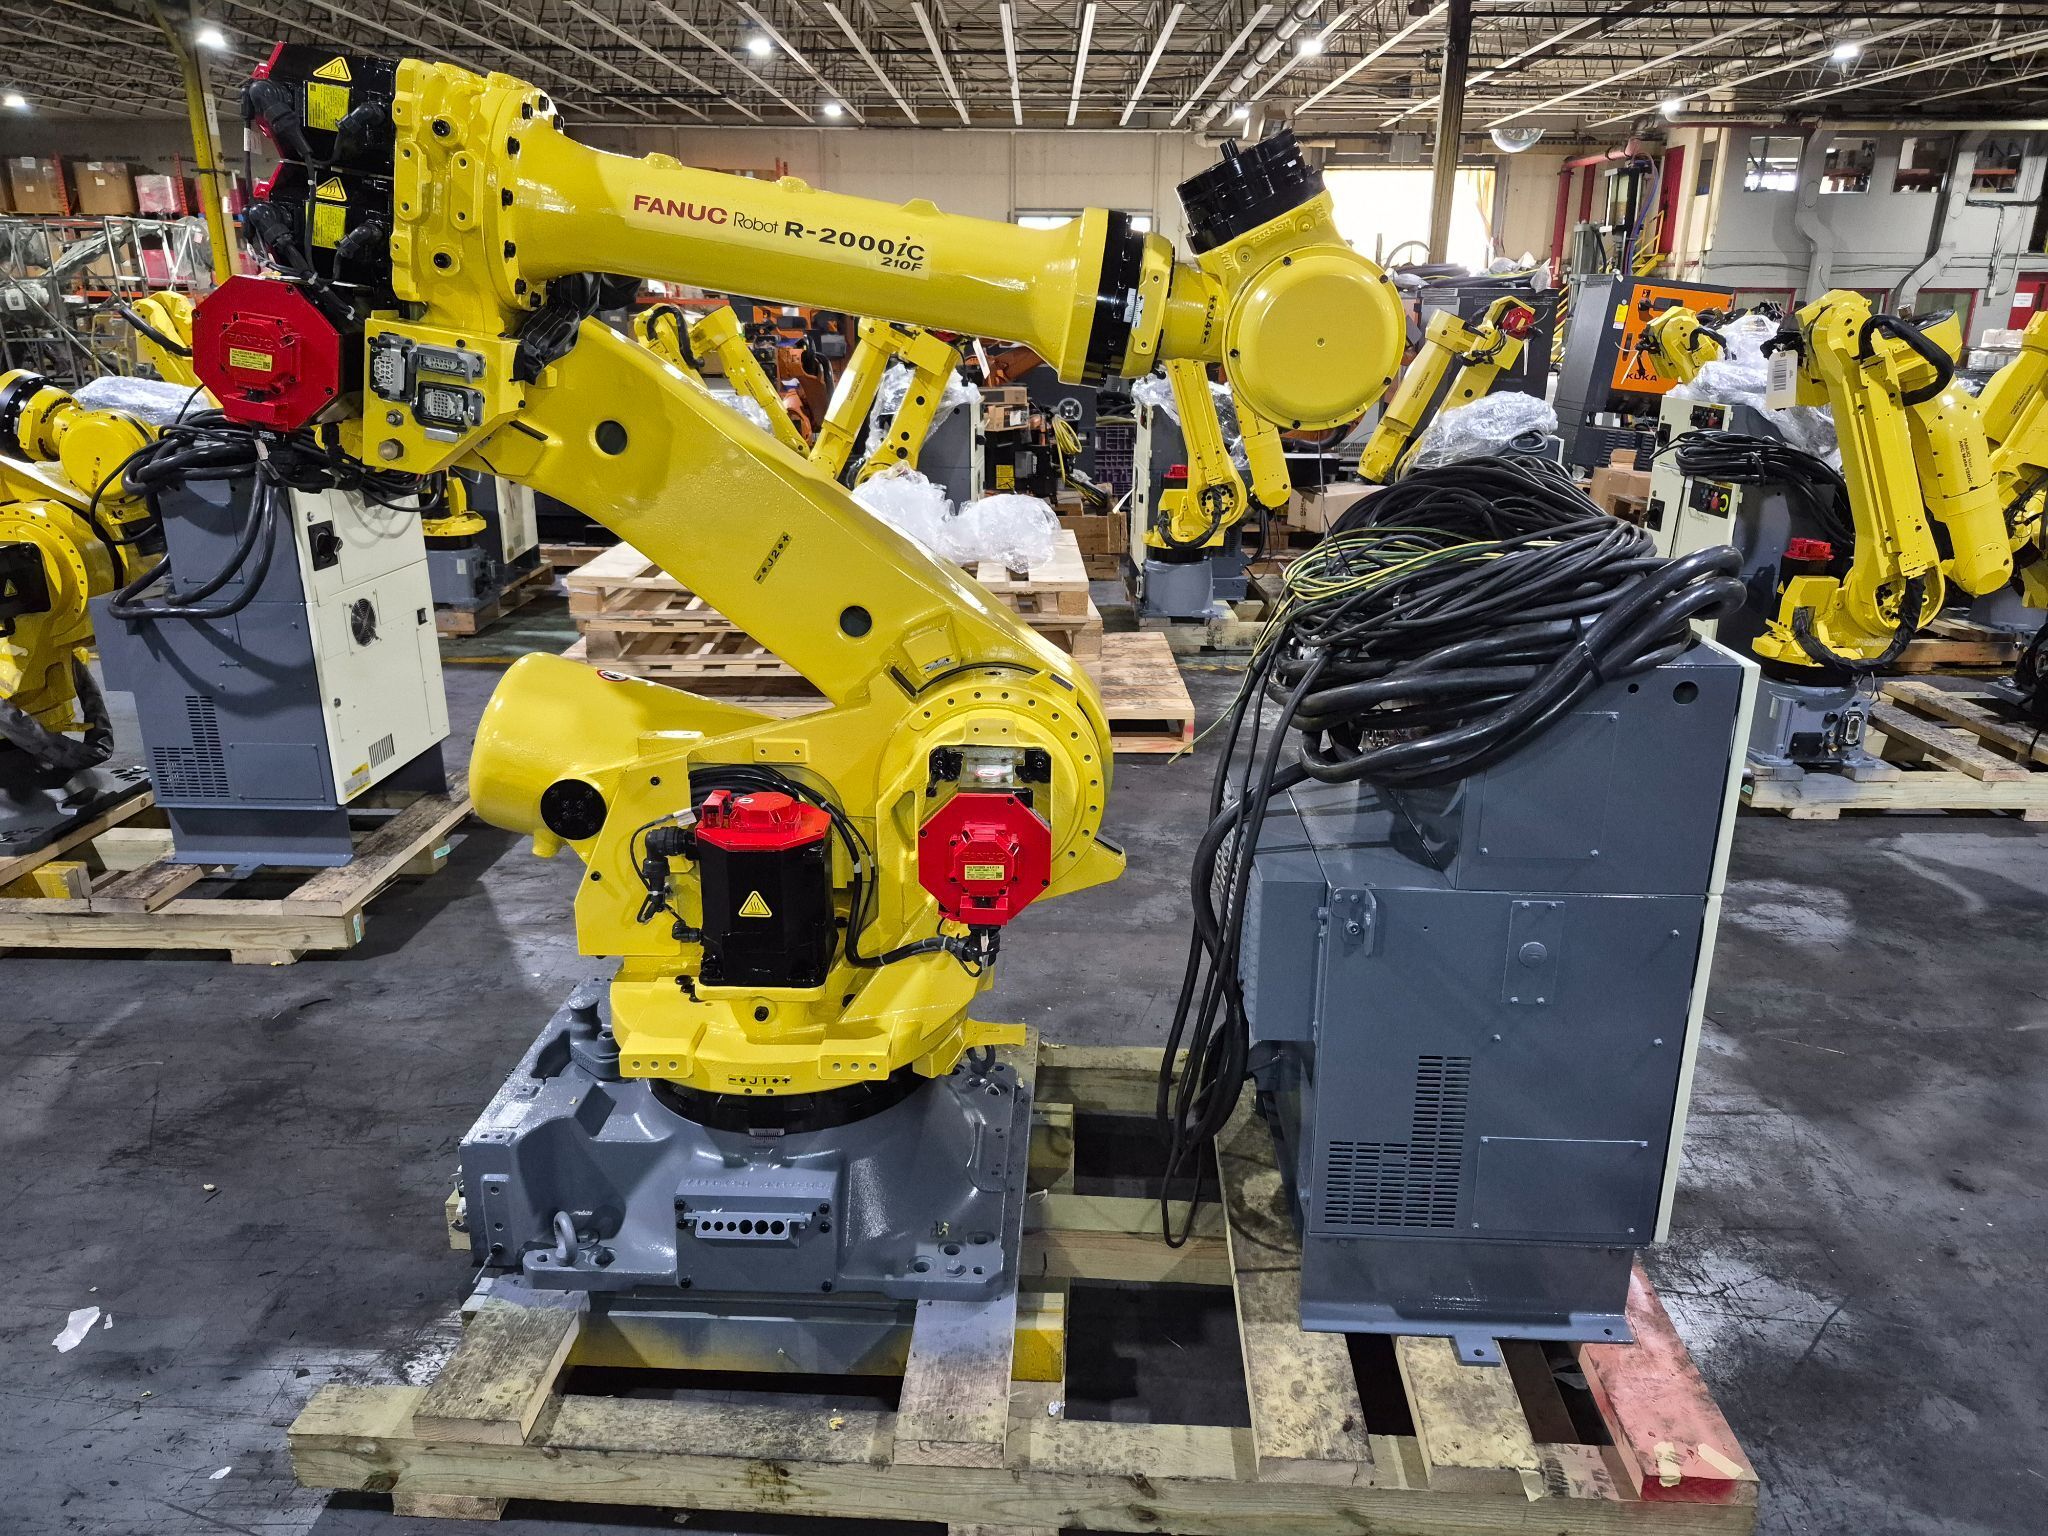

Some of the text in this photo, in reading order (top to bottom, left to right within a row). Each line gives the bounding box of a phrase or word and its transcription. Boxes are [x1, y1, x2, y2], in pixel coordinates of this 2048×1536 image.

[633, 194, 925, 261] FANUC Robot R-2000iC
[881, 257, 923, 272] 210F
